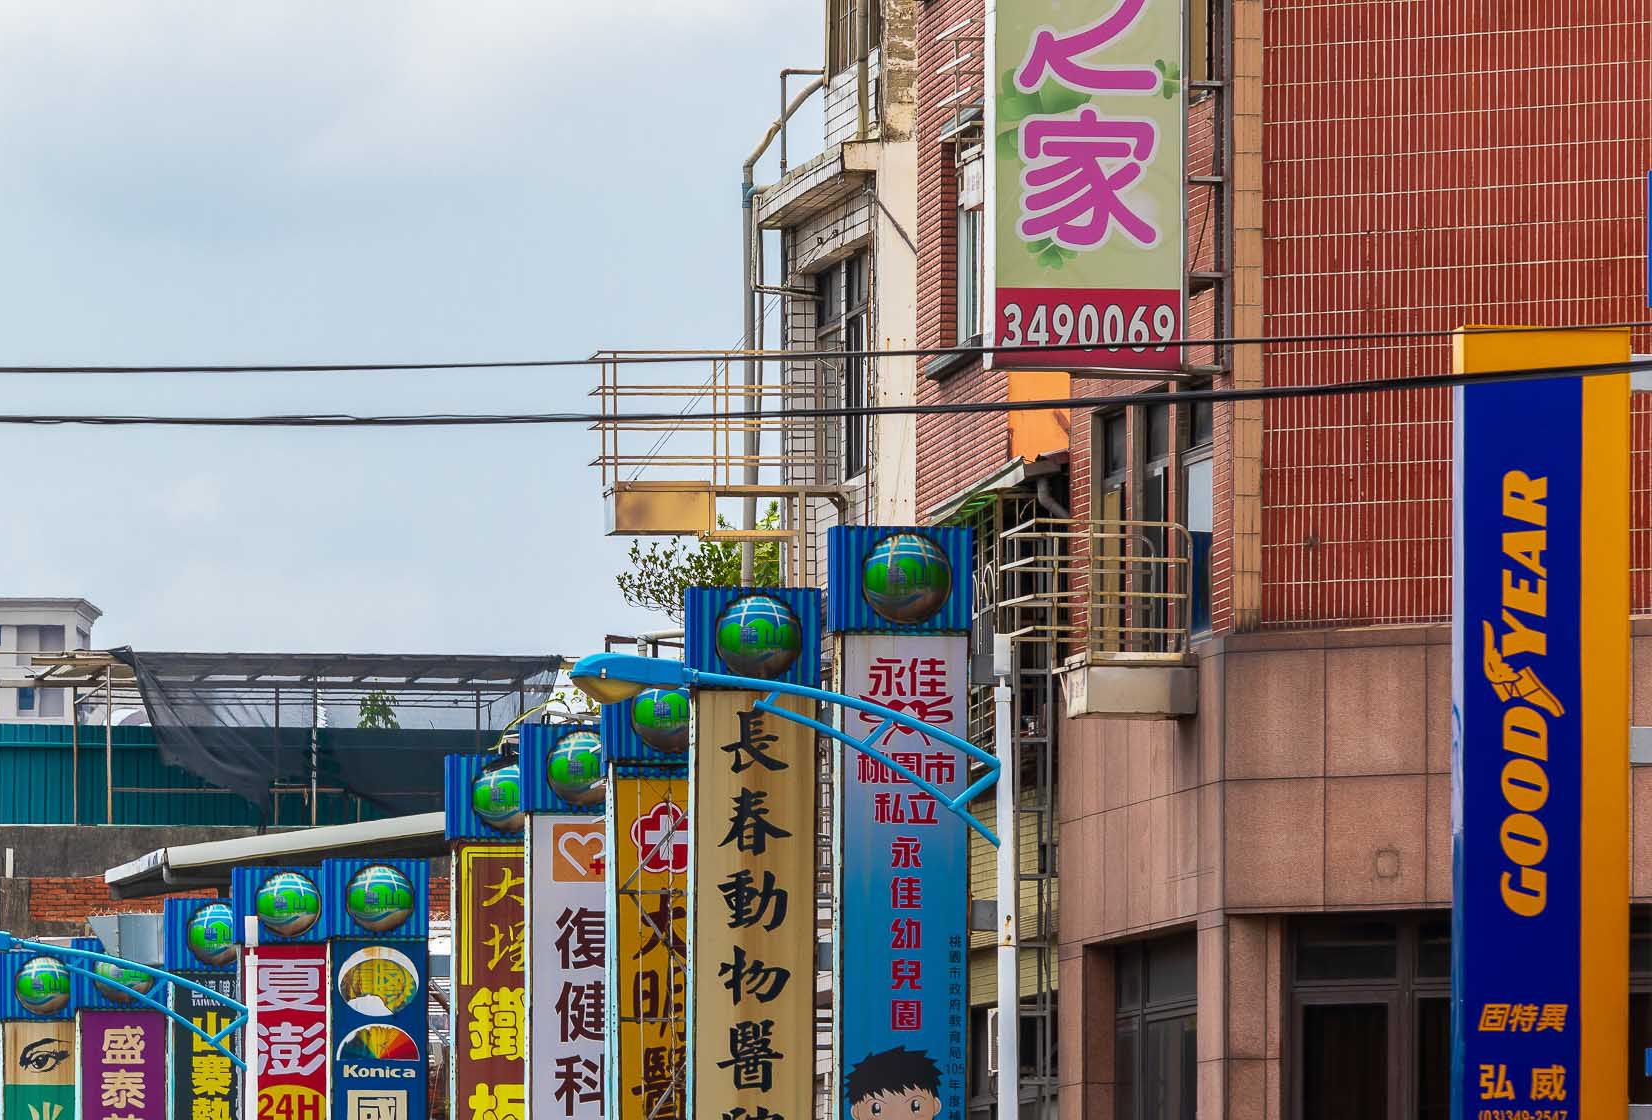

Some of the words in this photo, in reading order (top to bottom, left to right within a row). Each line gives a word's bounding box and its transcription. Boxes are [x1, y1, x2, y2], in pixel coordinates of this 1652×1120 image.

[1001, 303, 1176, 353] 3490069
[867, 657, 948, 697] 永佳
[1500, 470, 1549, 917] GOODYEAR
[874, 792, 939, 826] 私立
[891, 836, 923, 1032] 永佳幼兒園
[554, 906, 606, 1117] 復健科
[1478, 1003, 1568, 1033] 固特異
[343, 1064, 416, 1078] Konica
